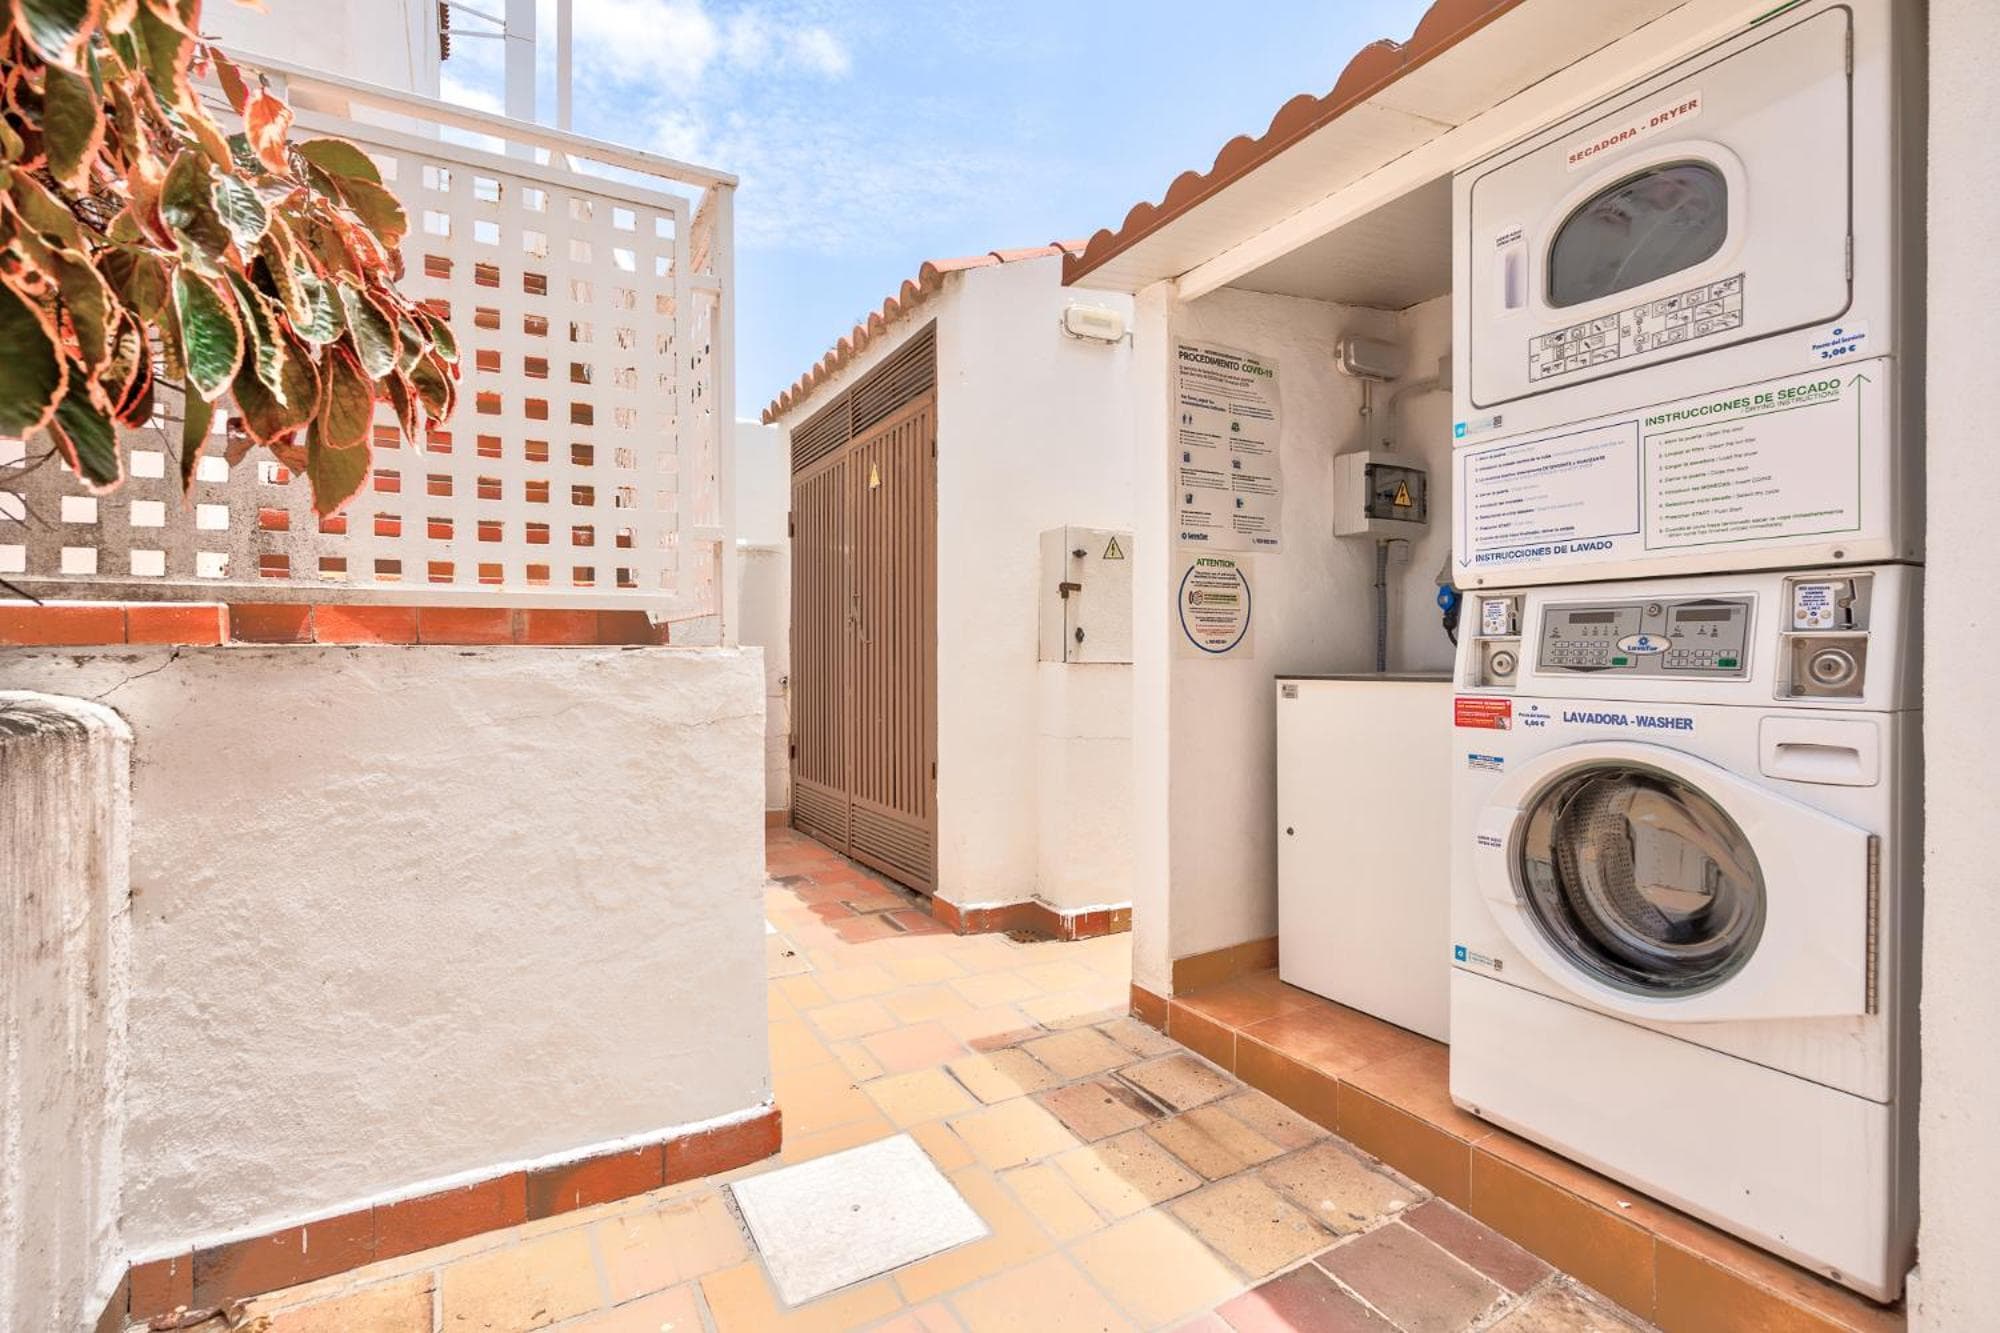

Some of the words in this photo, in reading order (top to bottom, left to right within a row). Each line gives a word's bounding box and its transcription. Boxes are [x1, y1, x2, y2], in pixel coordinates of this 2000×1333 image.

[1568, 128, 1637, 164] SECADORA
[1650, 99, 1698, 128] DRYER
[1178, 350, 1240, 371] PROCEDIMIENTO
[1241, 363, 1273, 379] COVID-19
[1644, 397, 1751, 426] INSTRUCCIONES
[1754, 392, 1774, 405] DE
[1777, 378, 1841, 400] SECADO
[1475, 547, 1551, 562] INSTRUCCIONES
[1553, 544, 1568, 554] DE
[1570, 540, 1613, 553] LAVADO
[1563, 711, 1628, 726] LAVADORA
[1635, 715, 1693, 730] WASHER
